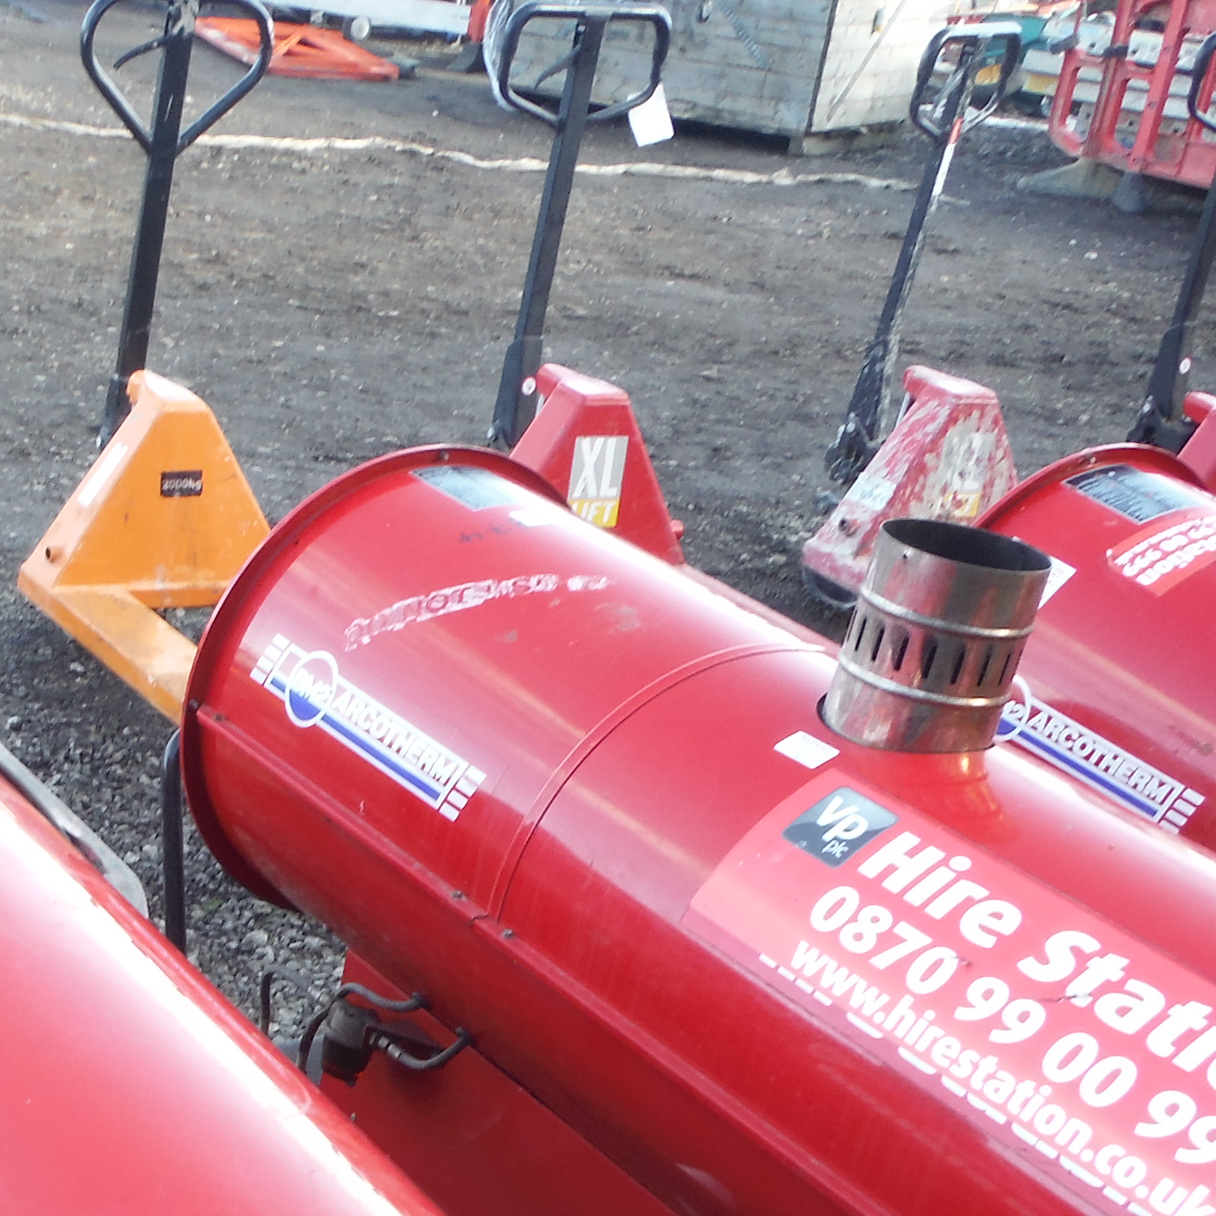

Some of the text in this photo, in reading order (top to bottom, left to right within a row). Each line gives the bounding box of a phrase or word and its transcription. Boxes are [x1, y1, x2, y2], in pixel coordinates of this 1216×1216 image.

[572, 437, 618, 498] XL
[333, 690, 462, 788] ARCOTHERM
[1027, 710, 1174, 806] ARCOTHERM
[857, 831, 1216, 1090] Hire Stati
[809, 886, 1216, 1164] 0870 99 00 99
